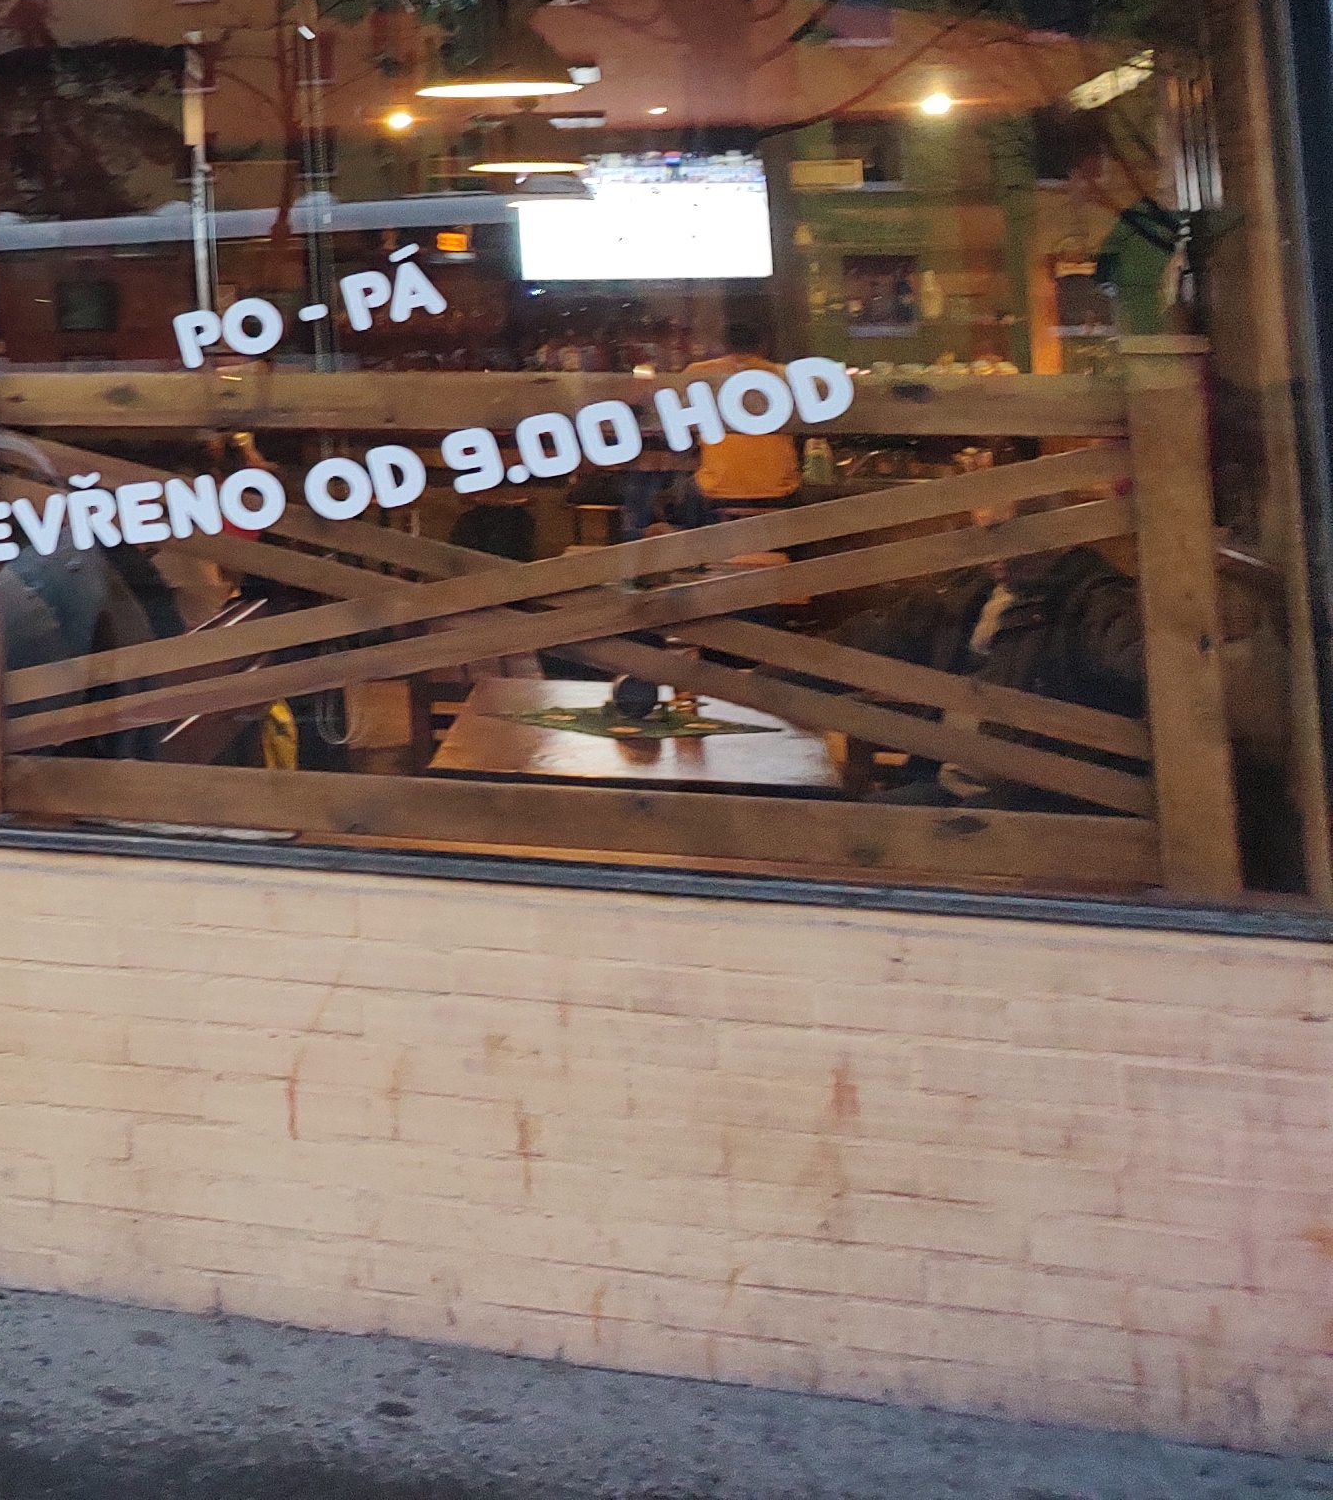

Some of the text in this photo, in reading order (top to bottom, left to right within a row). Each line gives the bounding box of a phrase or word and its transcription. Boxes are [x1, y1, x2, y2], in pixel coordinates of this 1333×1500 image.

[171, 296, 285, 370] PO
[339, 242, 449, 332] PÁ
[303, 443, 428, 523] OD
[442, 399, 643, 495] 9.00
[652, 355, 855, 453] HOD
